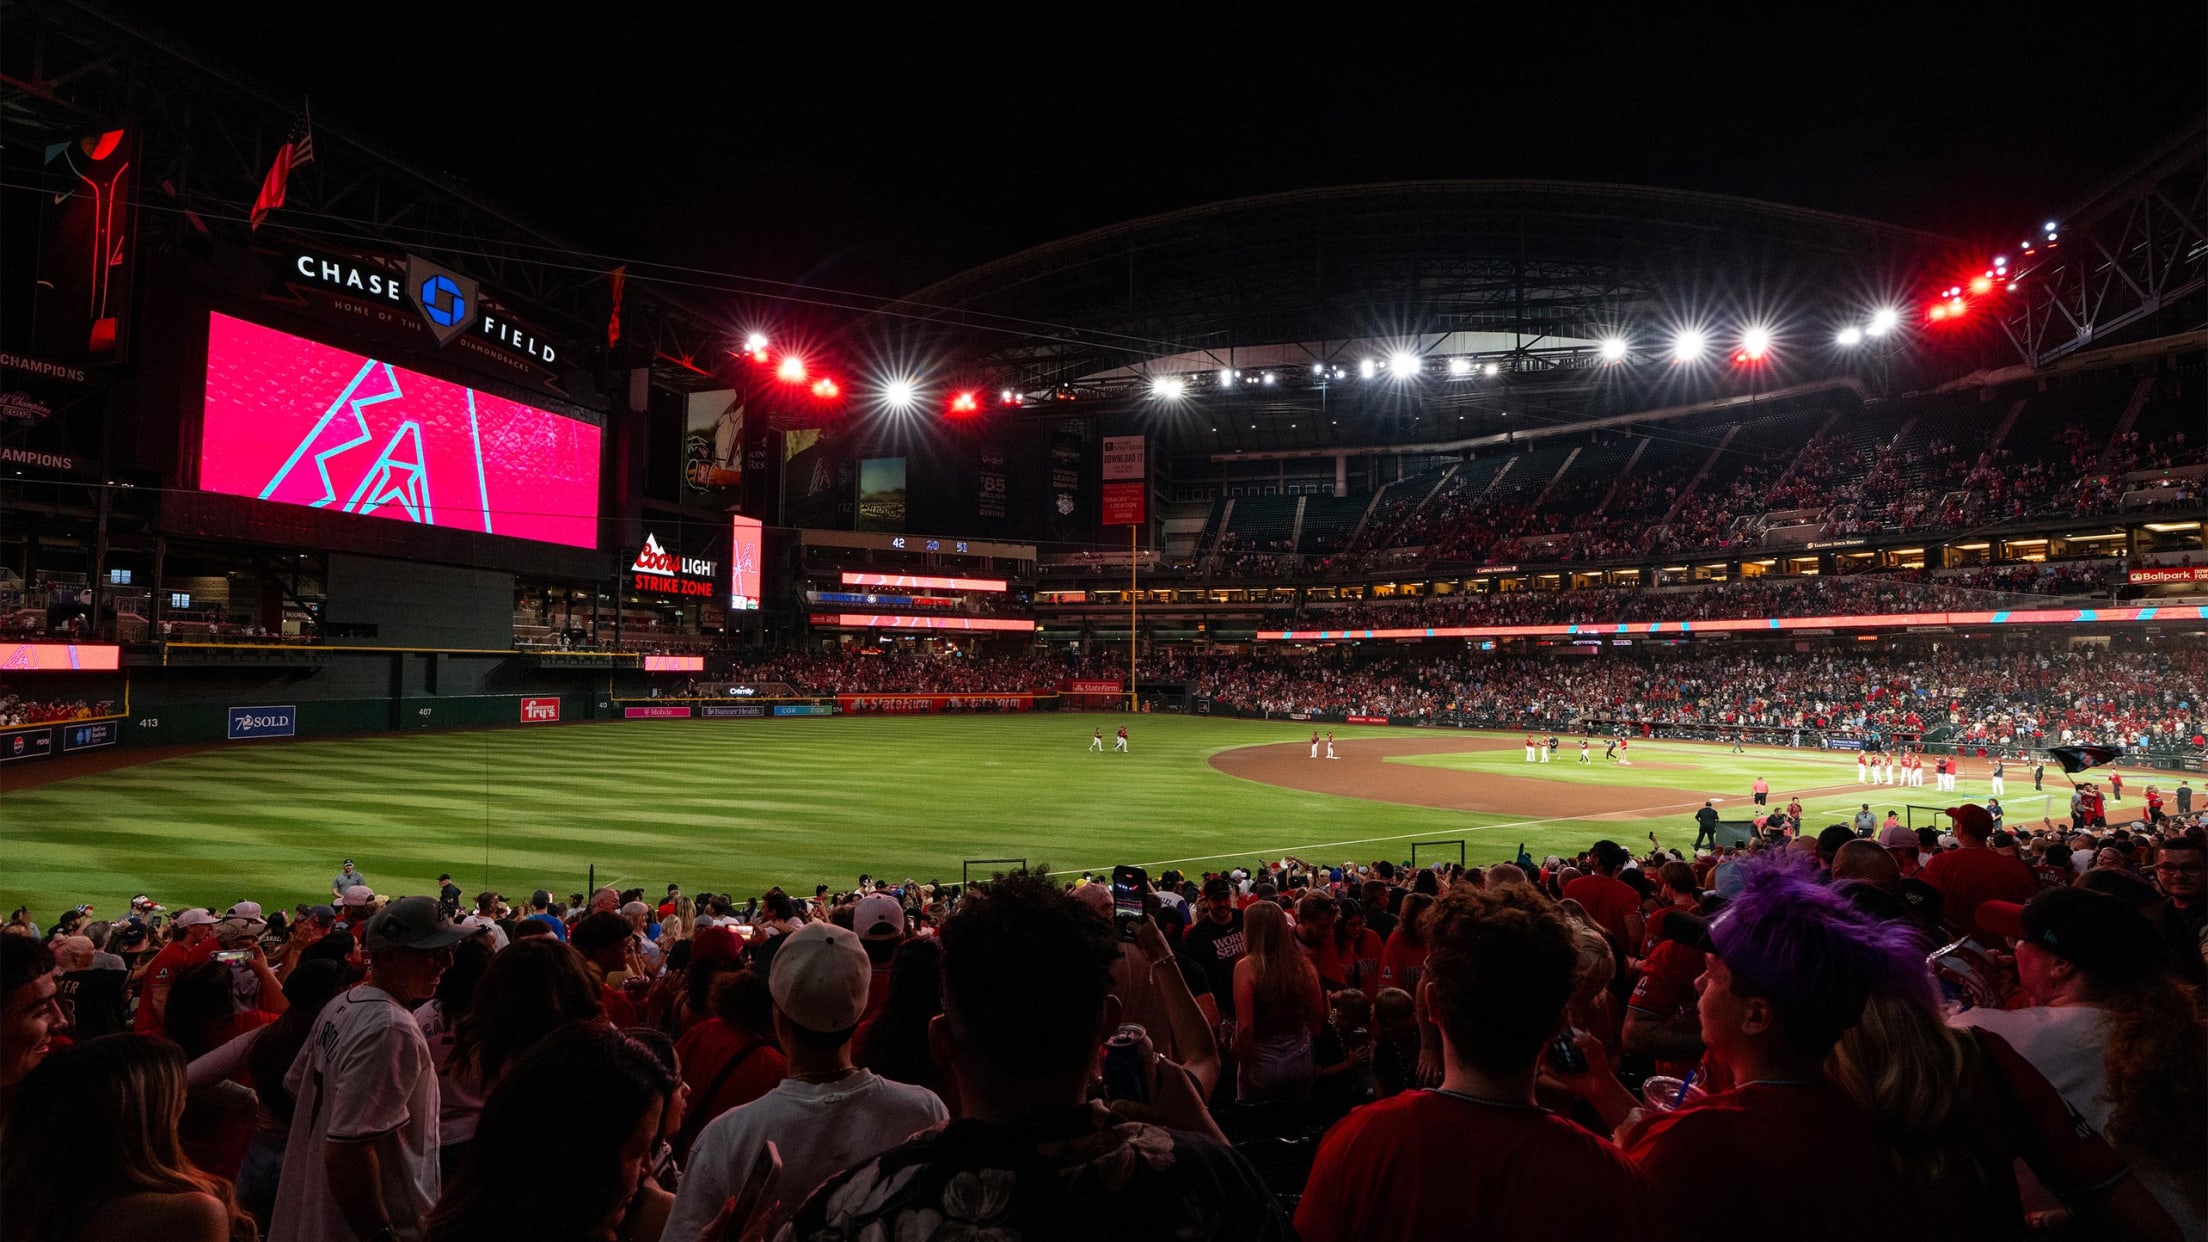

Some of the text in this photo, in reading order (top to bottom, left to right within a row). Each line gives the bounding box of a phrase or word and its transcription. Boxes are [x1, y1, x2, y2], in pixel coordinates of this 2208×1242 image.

[297, 255, 556, 364] CHASE FIELD
[334, 300, 423, 332] HOME OF THE
[460, 337, 529, 373] DIAMONDBACKS
[0, 353, 86, 382] CHAMPIONS
[0, 447, 73, 470] AMPIONS
[1104, 453, 1143, 464] DOWNLOAD IT
[892, 537, 905, 549] 42
[925, 539, 940, 551] 20
[956, 541, 968, 553] 51
[635, 543, 718, 578] Coors LIGHT
[634, 573, 714, 597] STRIKE ZONE
[2143, 571, 2191, 581] Ballpark
[418, 708, 432, 717] 407
[525, 700, 556, 719] fry's
[650, 707, 673, 716] Mobile
[714, 706, 759, 715] Banner Health
[139, 717, 159, 728] 413
[1211, 931, 1244, 949] WORL
[1215, 943, 1248, 961] SERI
